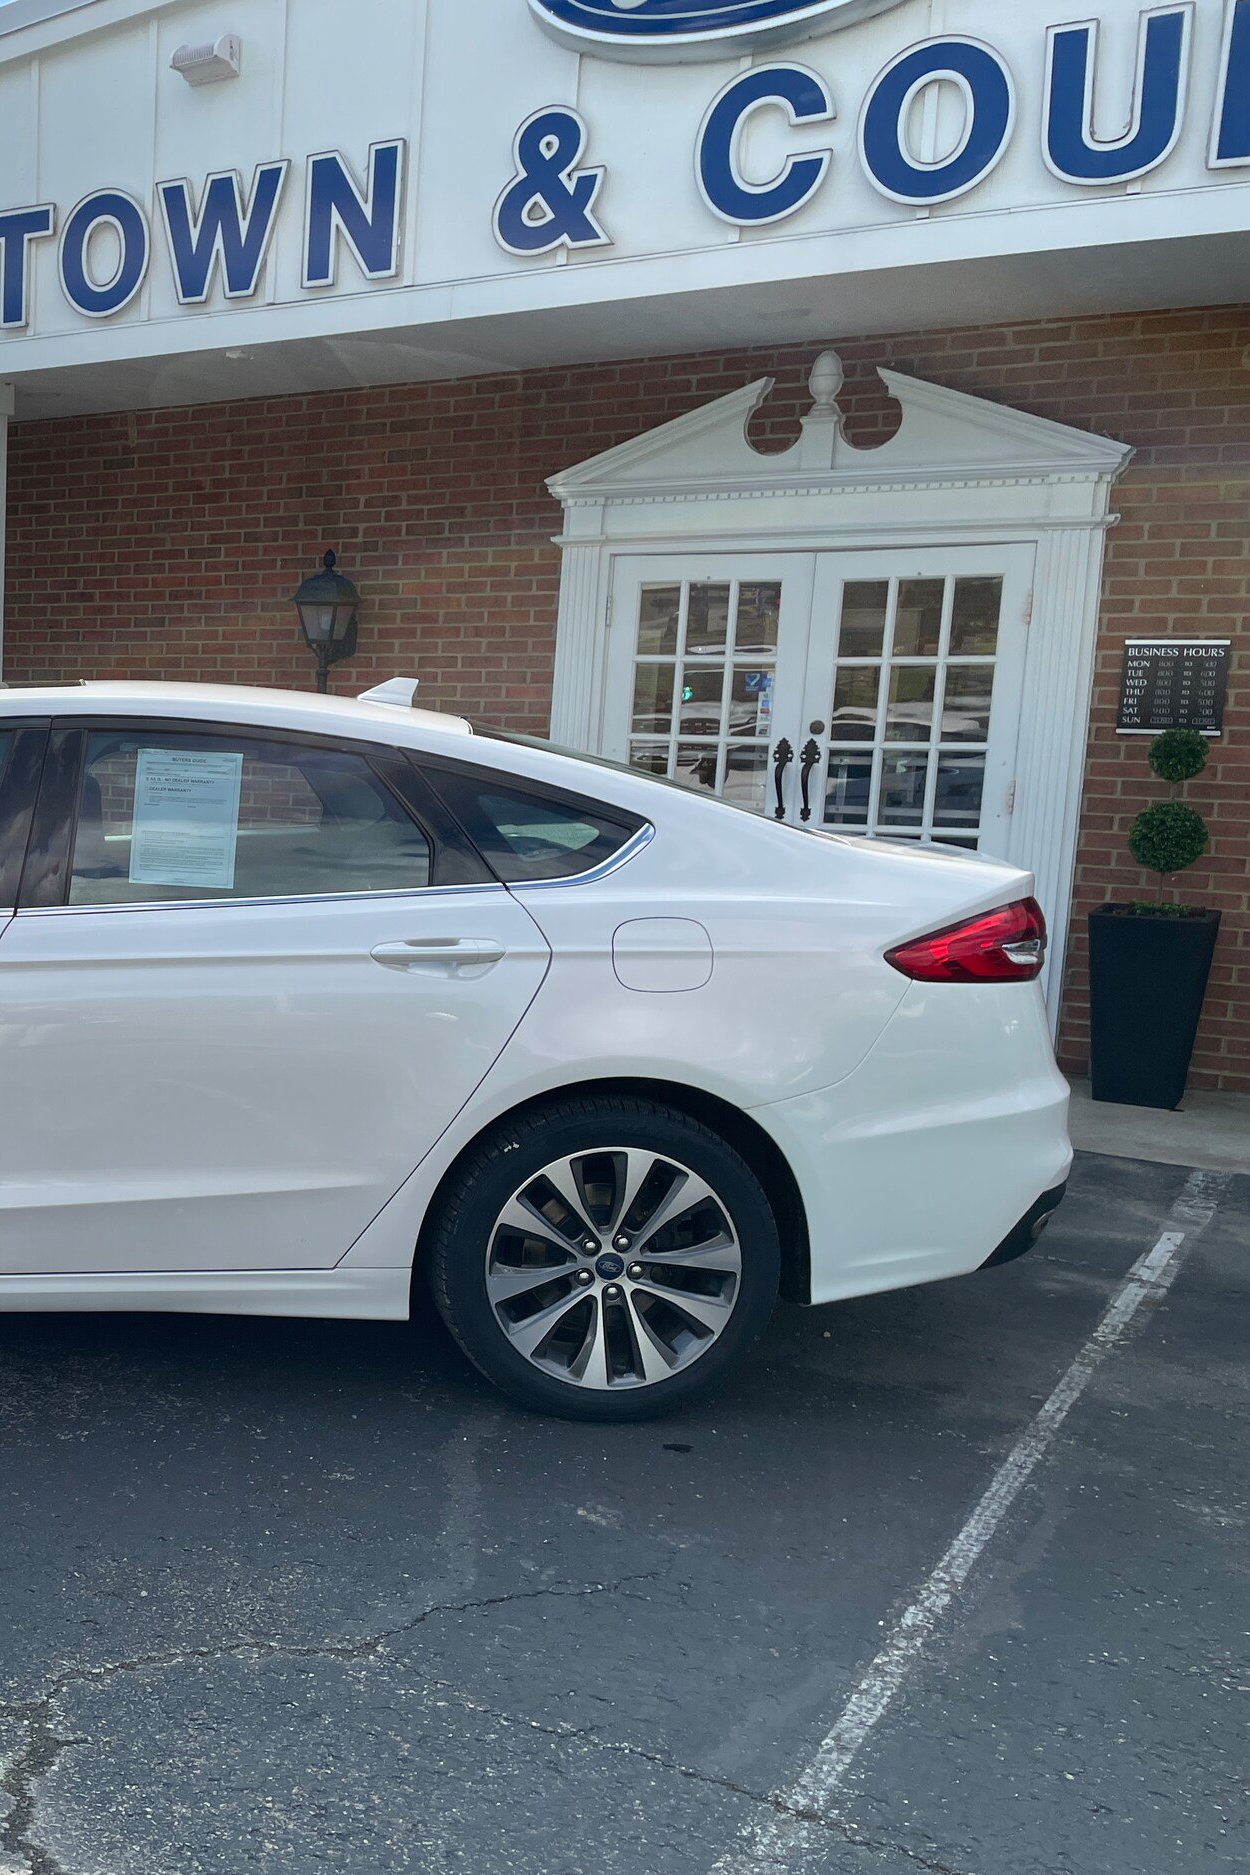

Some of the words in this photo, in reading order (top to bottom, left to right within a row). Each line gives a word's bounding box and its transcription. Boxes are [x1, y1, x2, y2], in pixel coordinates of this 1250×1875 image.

[492, 104, 614, 257] &
[1128, 647, 1179, 657] BUSINESS
[1183, 647, 1225, 657] HOURS
[1127, 669, 1144, 677] TUE
[1123, 697, 1137, 705] FRI
[1122, 706, 1139, 714] SAT
[1121, 715, 1141, 723] SUN
